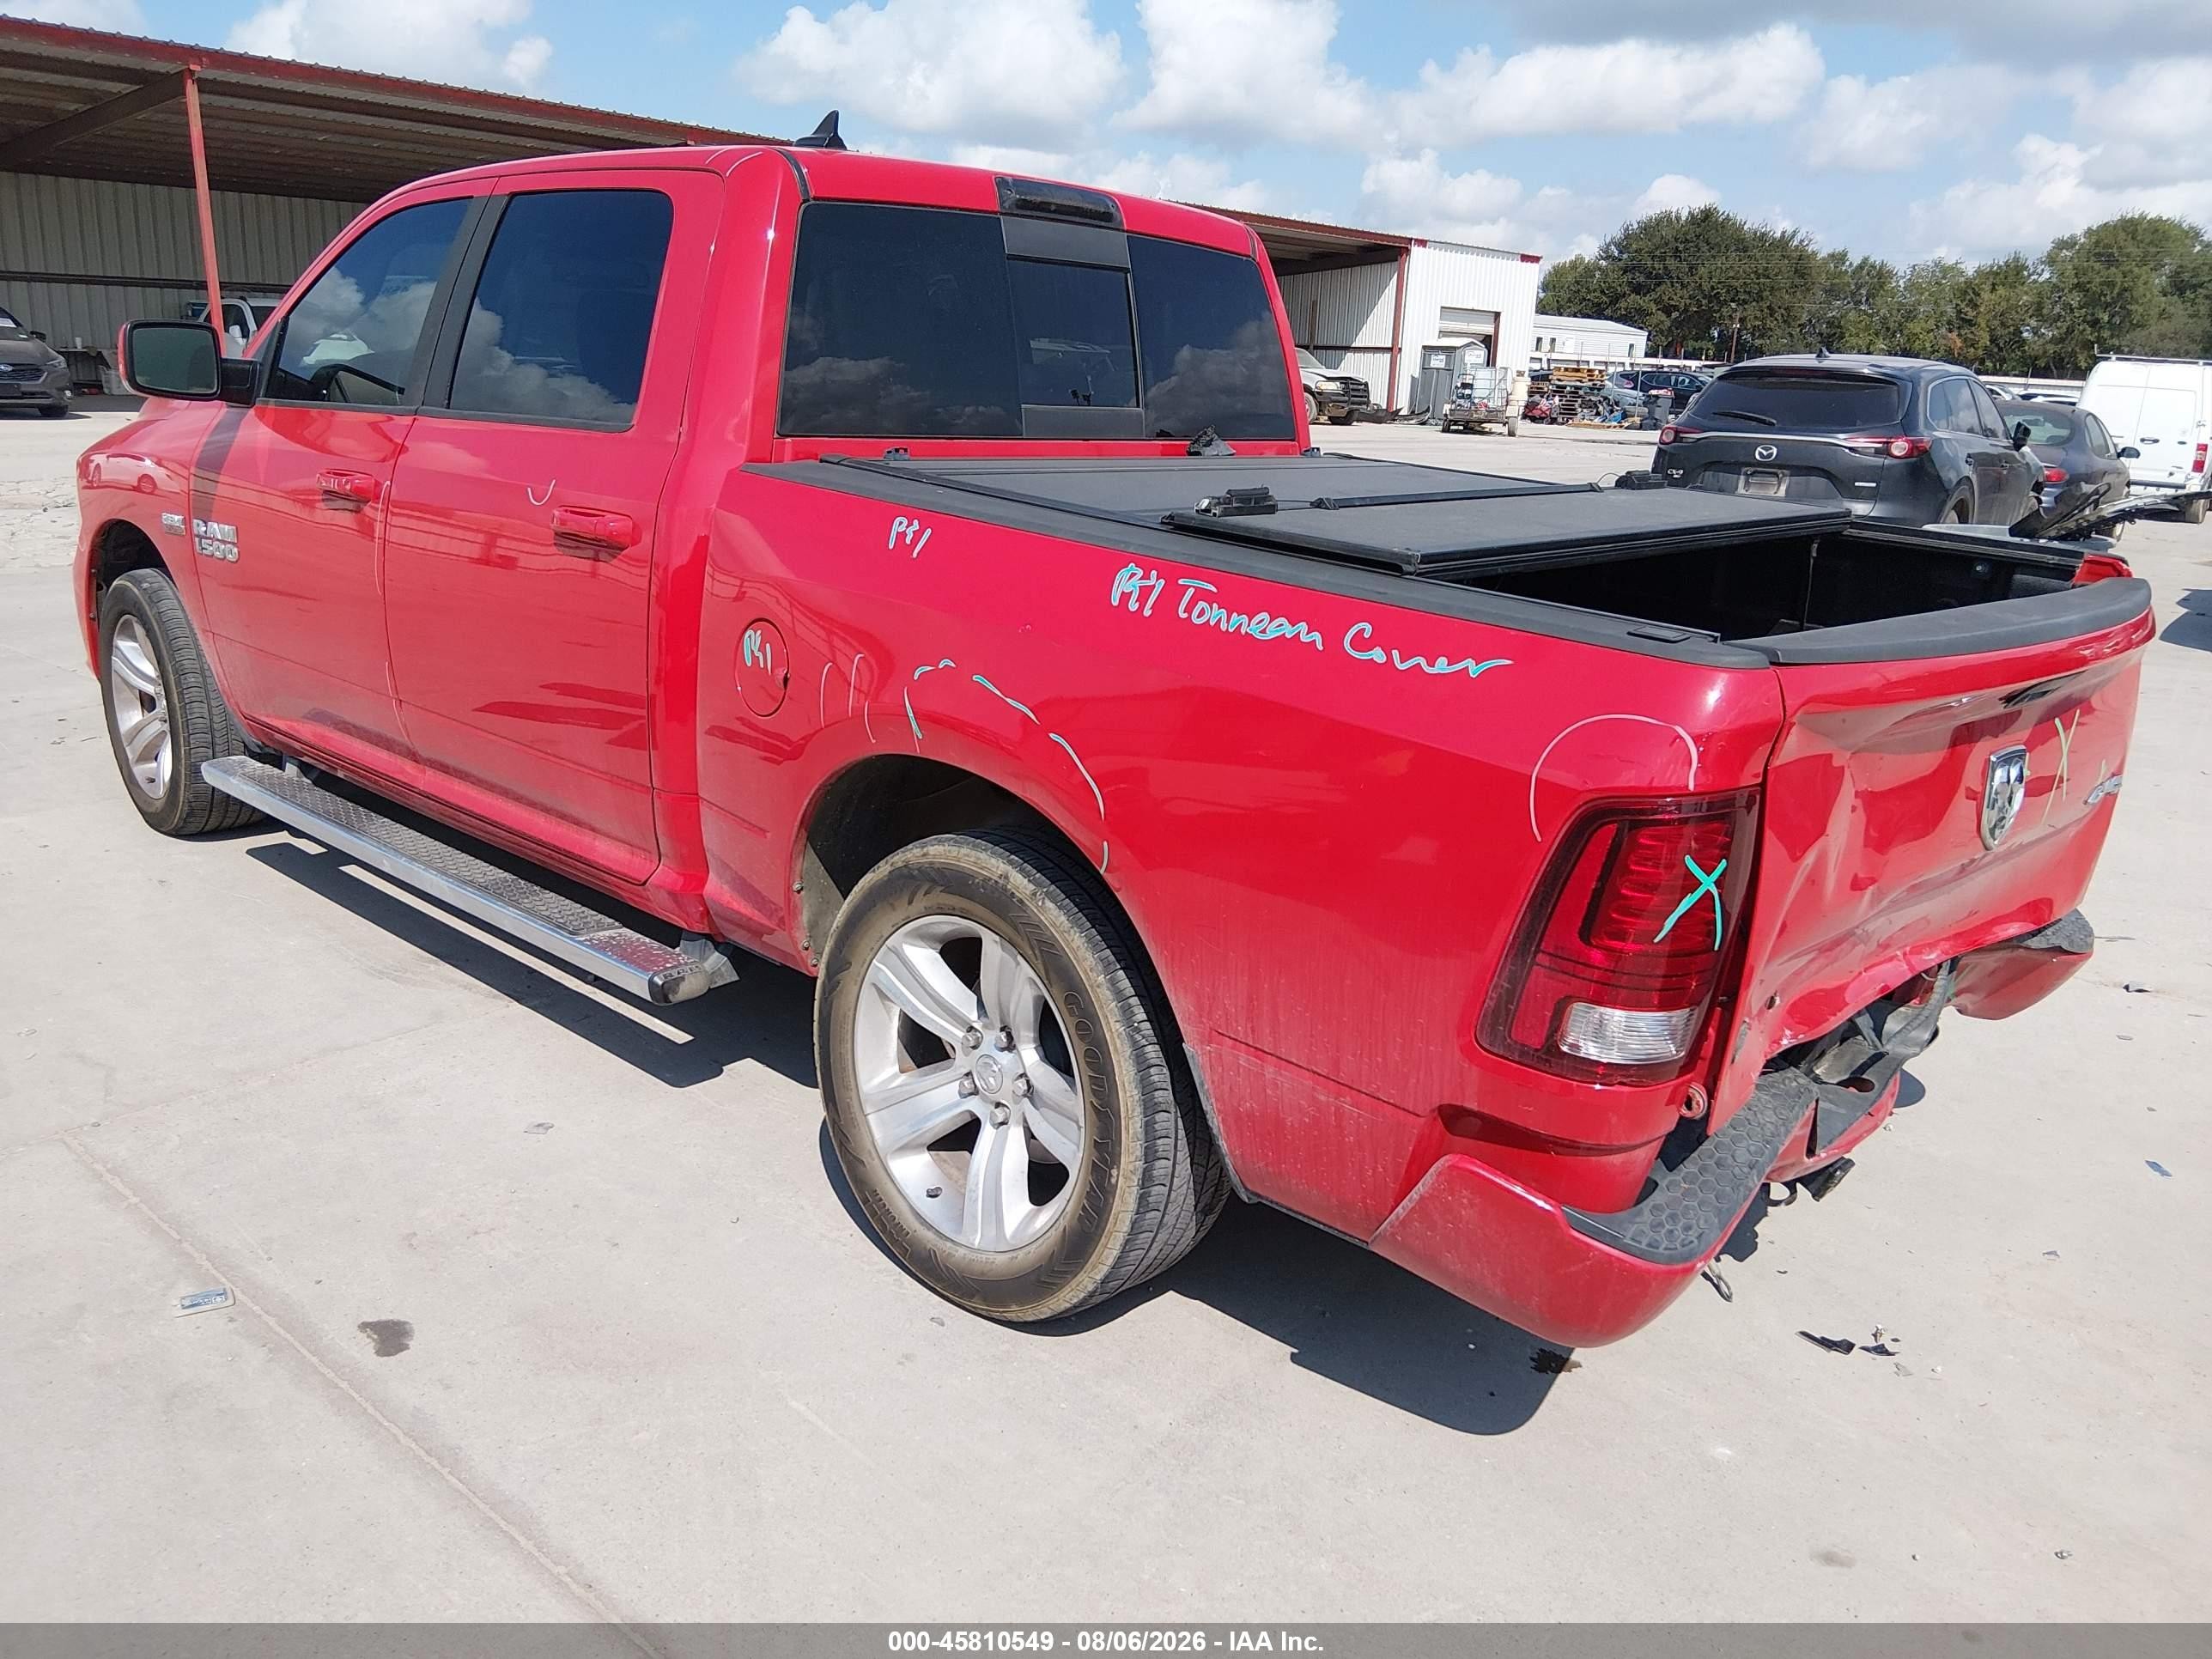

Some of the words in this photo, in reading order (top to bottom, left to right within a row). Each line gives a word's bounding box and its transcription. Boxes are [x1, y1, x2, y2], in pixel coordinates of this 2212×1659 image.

[193, 519, 238, 543] RAM
[195, 538, 239, 562] 1500
[1343, 621, 1515, 678] Cover
[1062, 988, 1115, 1234] GOODYEAR
